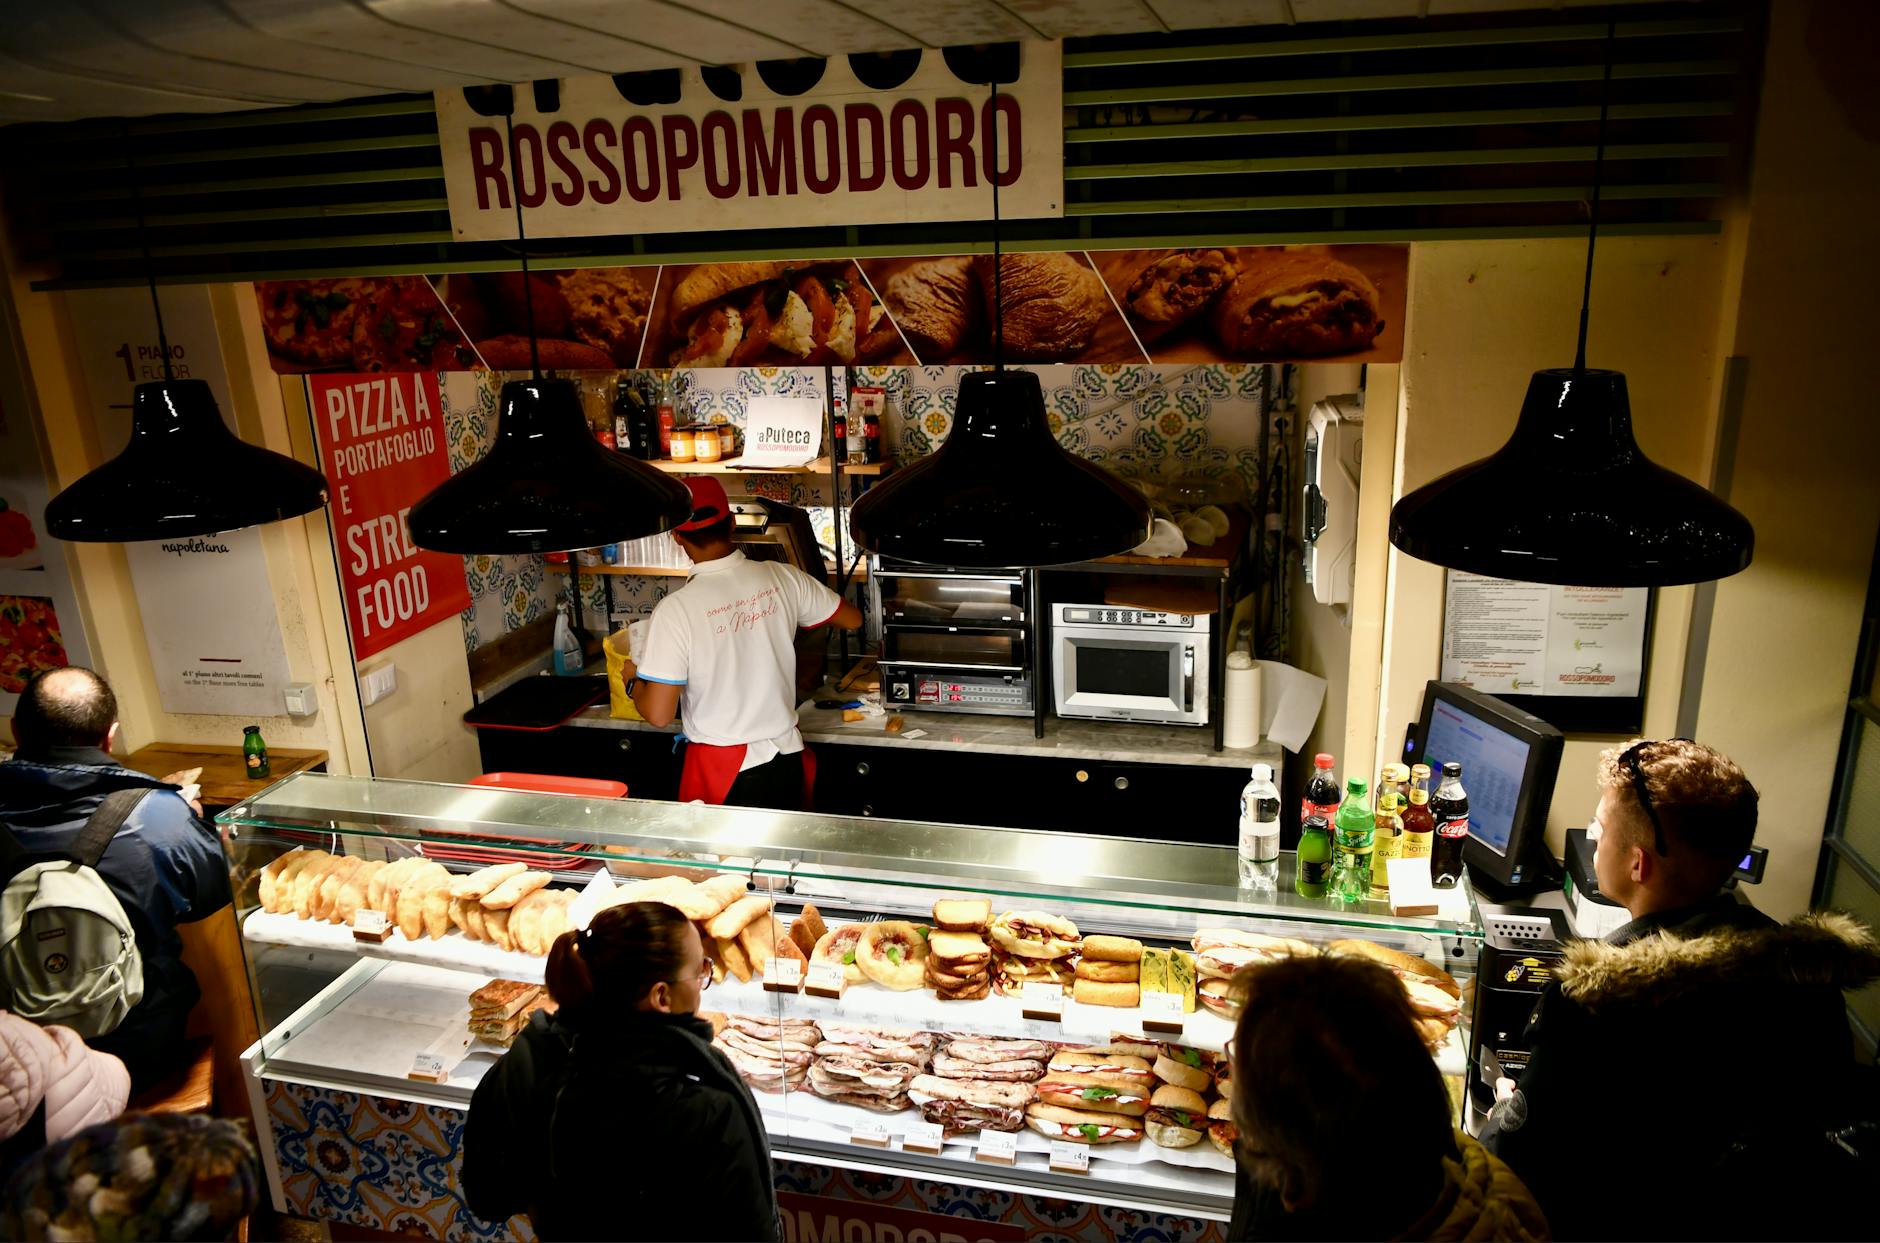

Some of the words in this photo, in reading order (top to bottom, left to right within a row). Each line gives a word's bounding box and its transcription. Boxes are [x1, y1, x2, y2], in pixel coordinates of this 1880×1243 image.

[468, 93, 1023, 210] ROSSOPOMODORO
[116, 343, 136, 382] 1
[325, 376, 409, 442] PIZZA
[413, 372, 432, 423] A
[334, 426, 436, 479] PORTAFOGLIO
[766, 426, 811, 444] Puteca
[340, 485, 352, 515] E
[162, 538, 230, 557] napoletana
[347, 506, 425, 577] STRE
[357, 564, 430, 637] FOOD
